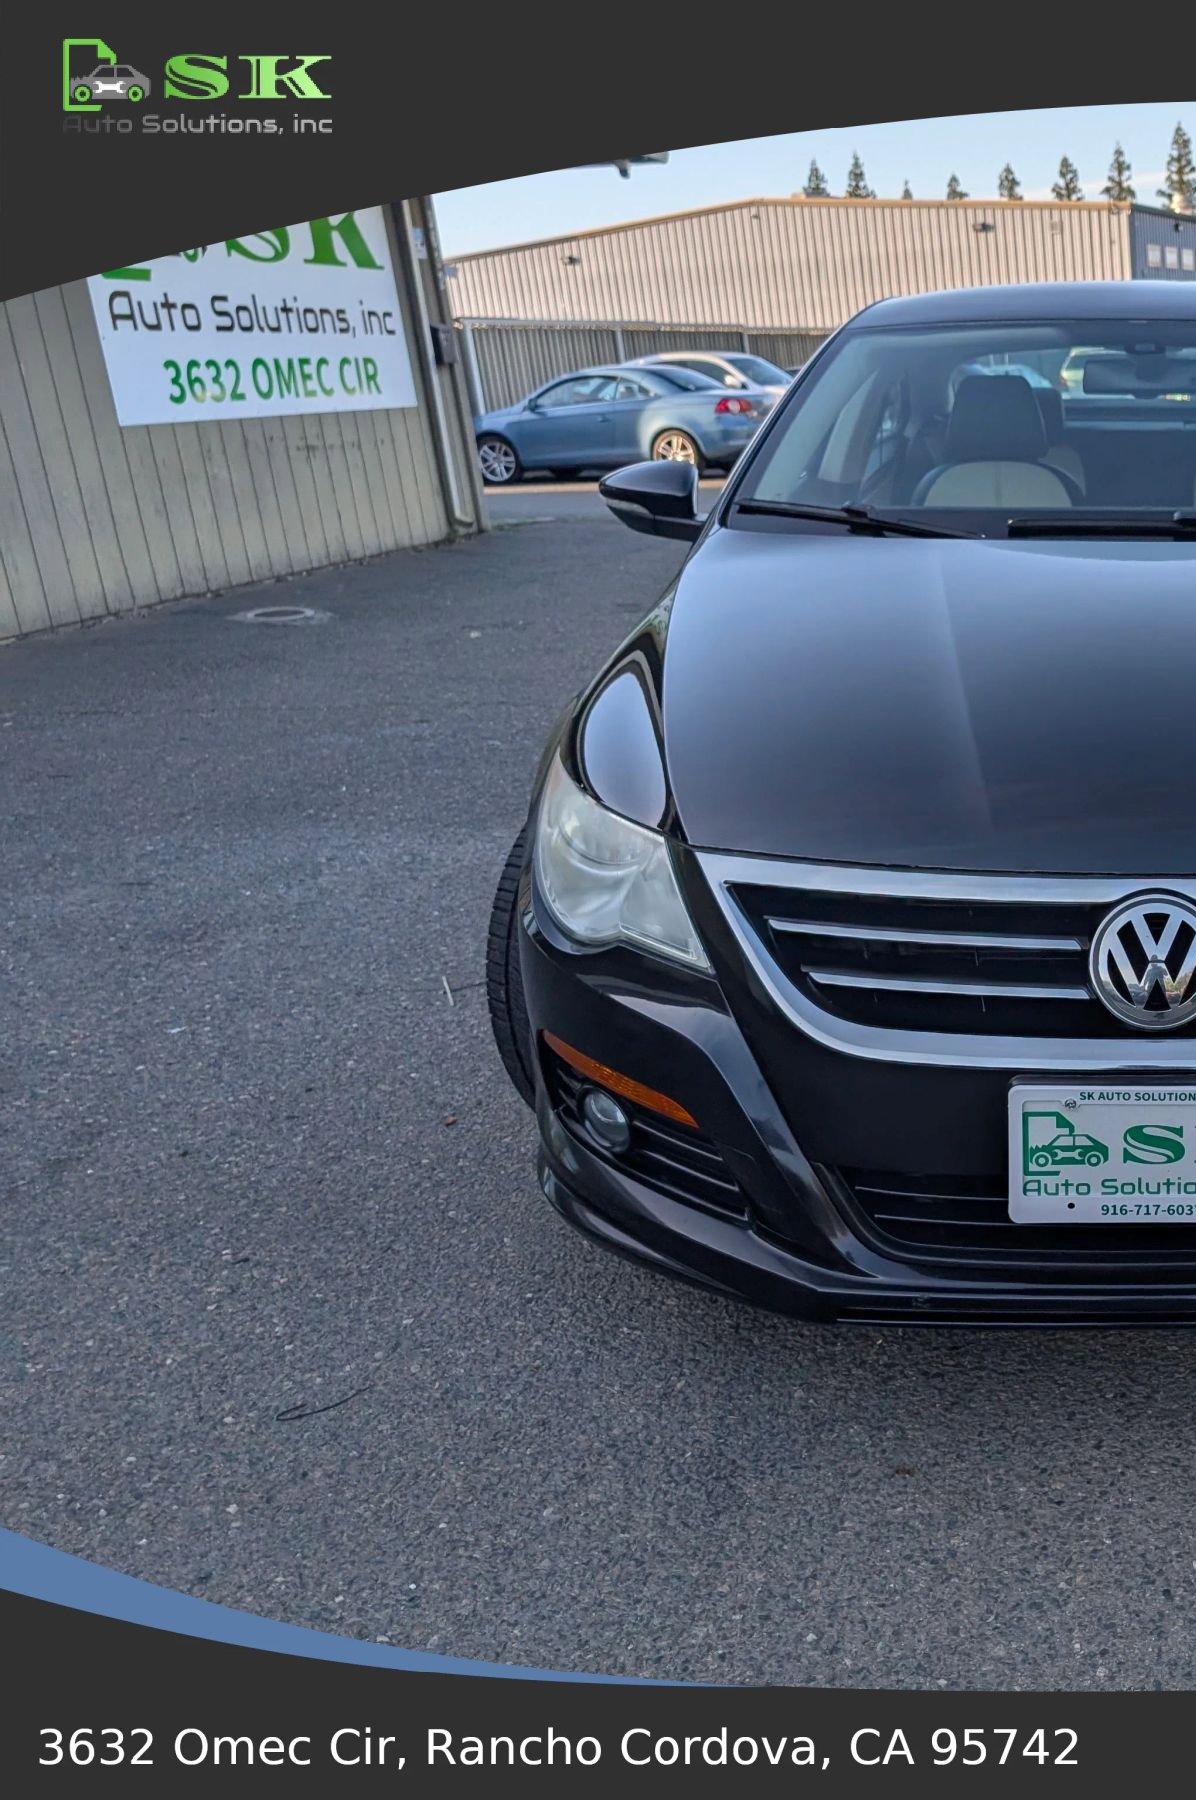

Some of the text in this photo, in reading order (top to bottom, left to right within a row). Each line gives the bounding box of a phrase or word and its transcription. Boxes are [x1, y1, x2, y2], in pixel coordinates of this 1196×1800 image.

[108, 290, 397, 338] Auto Solutions, inc
[162, 356, 383, 405] 3632 OMEC CIR
[1079, 1091, 1096, 1101] SK
[1097, 1091, 1131, 1102] AUTO
[1022, 1178, 1091, 1197] Auto
